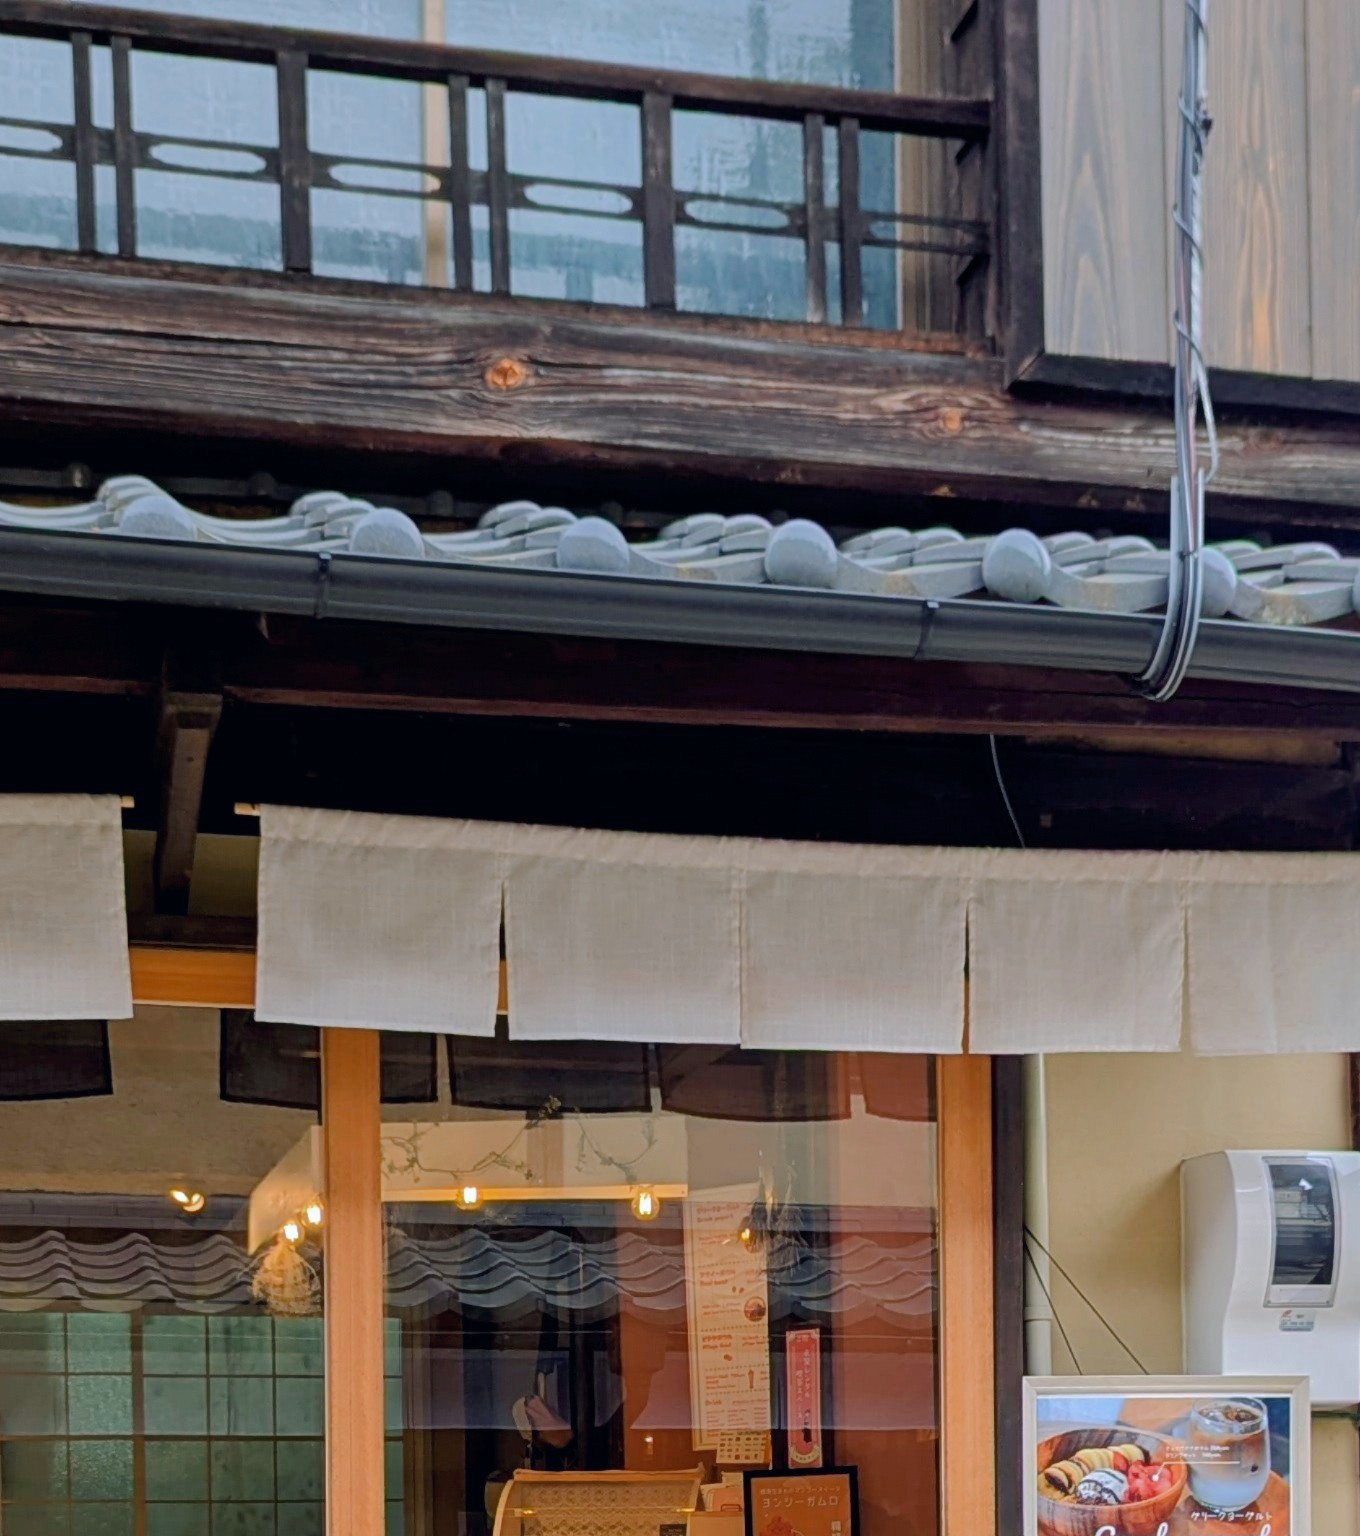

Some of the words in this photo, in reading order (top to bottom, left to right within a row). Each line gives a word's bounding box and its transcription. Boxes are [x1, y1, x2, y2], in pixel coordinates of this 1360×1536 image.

[1191, 1511, 1272, 1522] グリークヨーグルト
